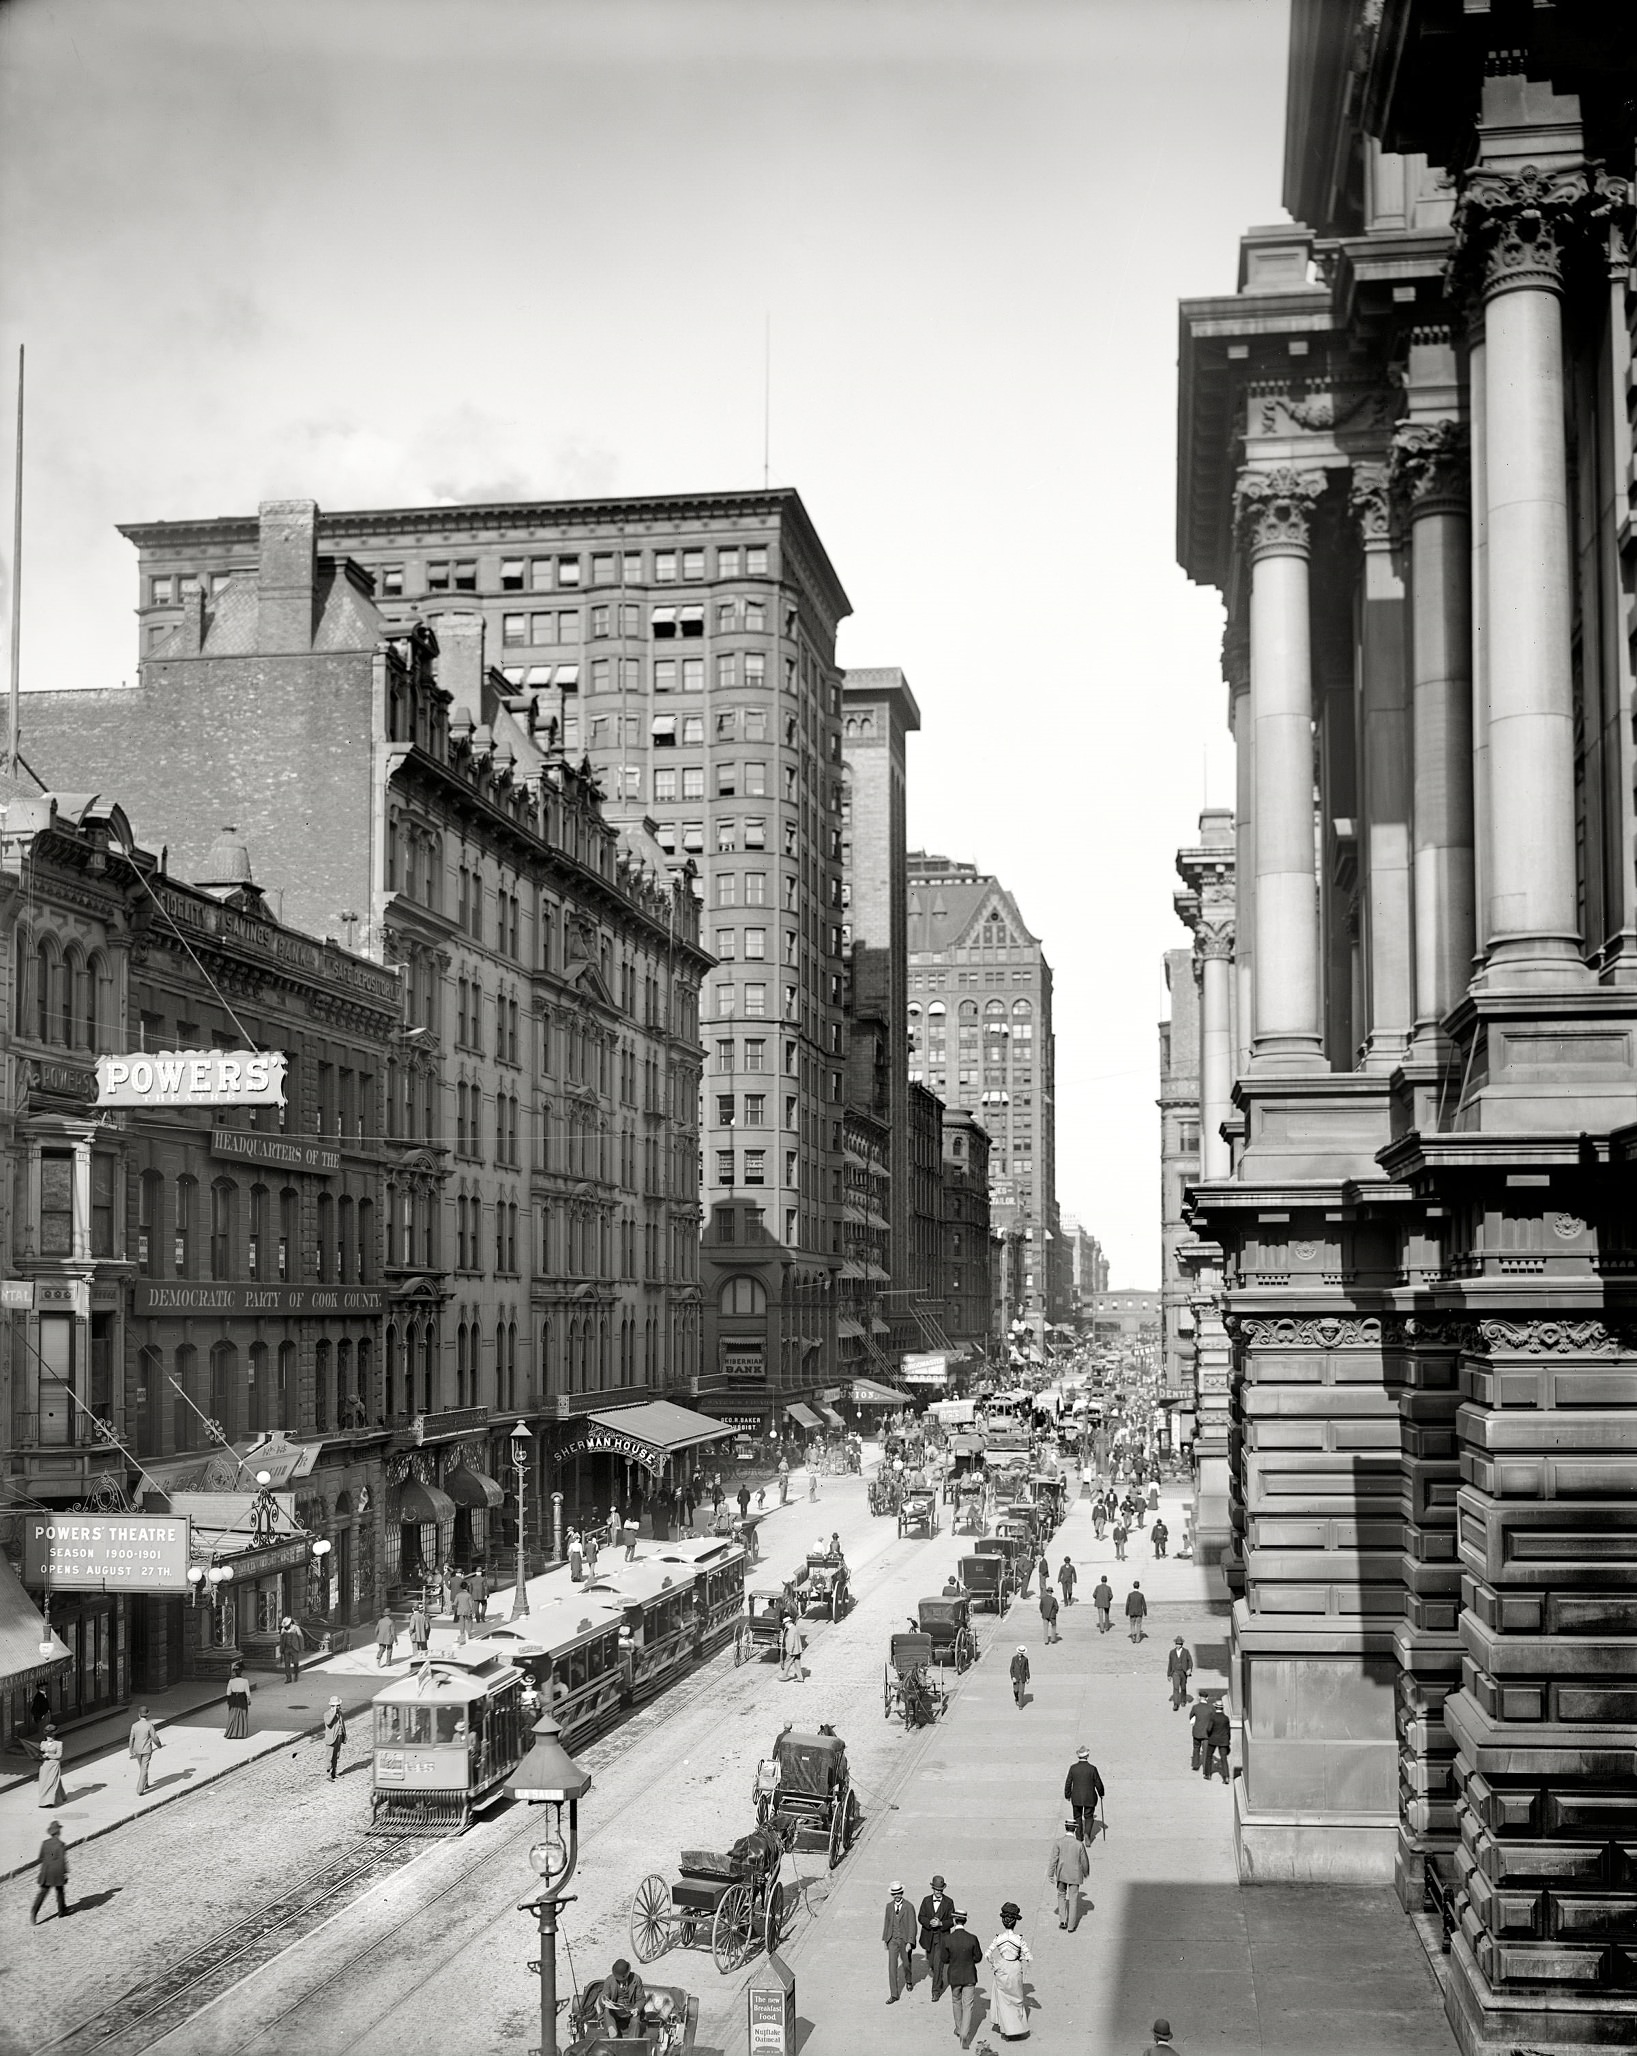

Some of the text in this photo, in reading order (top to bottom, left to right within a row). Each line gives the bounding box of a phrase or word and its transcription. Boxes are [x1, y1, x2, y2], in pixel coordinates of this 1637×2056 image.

[160, 891, 206, 929] FIDELITY
[225, 915, 269, 947] SAVINGS
[277, 938, 306, 966] BANK
[105, 1058, 279, 1094] POWERS'
[144, 1092, 236, 1102] THEATRE
[215, 1132, 340, 1169] HEADQUARTERS OF THE
[148, 1288, 382, 1308] DEMOCRATIC PARTY OF COOK COUNTY.
[840, 1390, 874, 1399] UNION
[553, 1437, 656, 1464] SHERMAN HOUSE
[35, 1526, 176, 1542] POWERS' THEATRE
[49, 1547, 161, 1559] SEASON 1900-1901
[40, 1564, 80, 1575] OPENS
[86, 1565, 132, 1576] AUGUST
[141, 1566, 153, 1576] 27
[753, 2004, 782, 2012] Breakfast
[759, 2013, 776, 2021] Food
